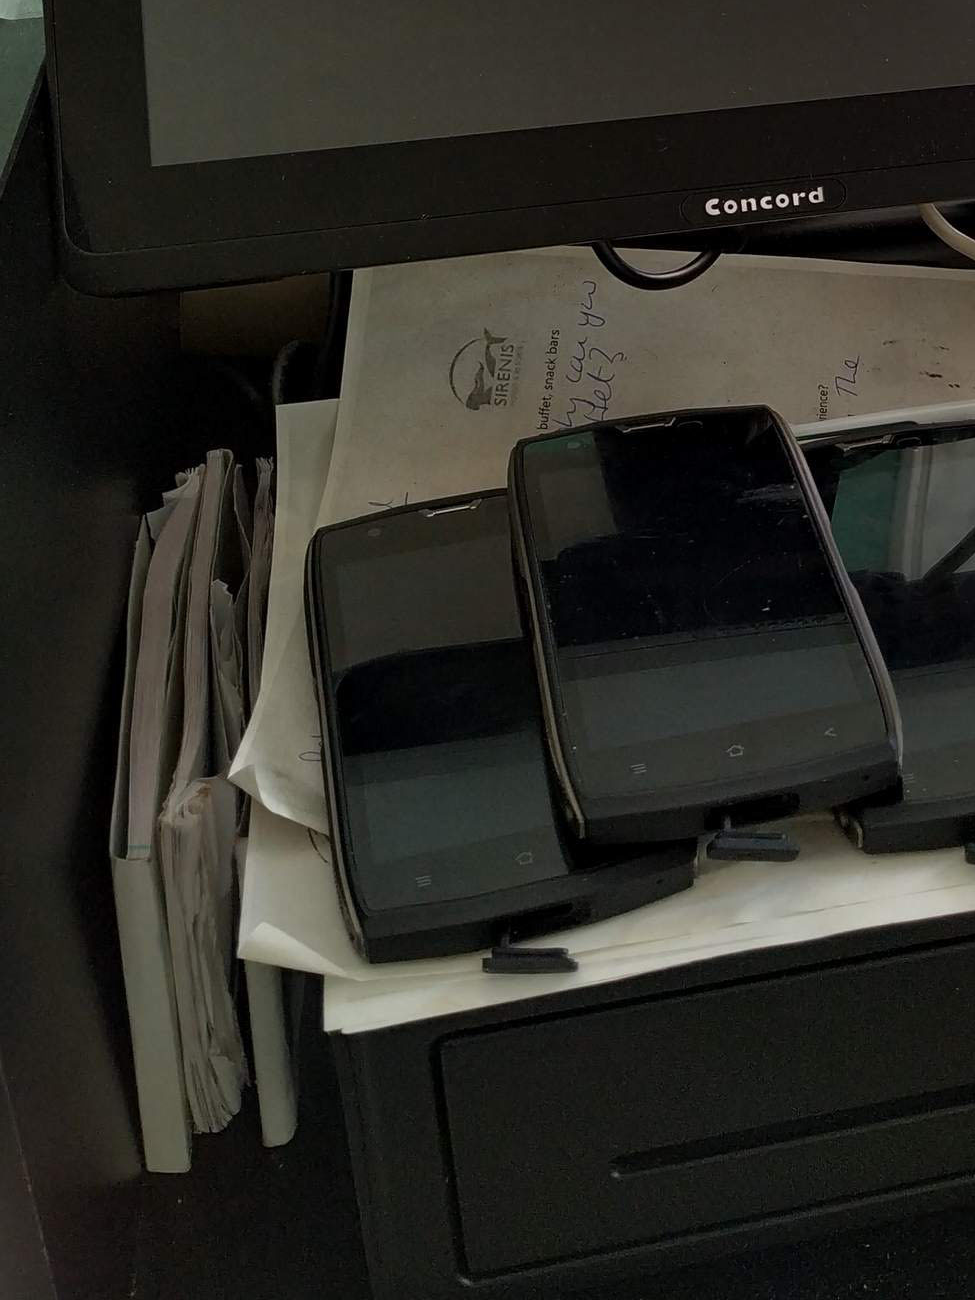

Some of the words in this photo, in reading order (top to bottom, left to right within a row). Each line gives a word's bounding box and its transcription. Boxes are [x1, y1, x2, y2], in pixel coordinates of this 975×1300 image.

[705, 186, 824, 215] Concord
[546, 329, 560, 355] bars
[495, 344, 514, 407] SIRENIS
[543, 356, 556, 390] snack
[537, 393, 553, 430] buffet,
